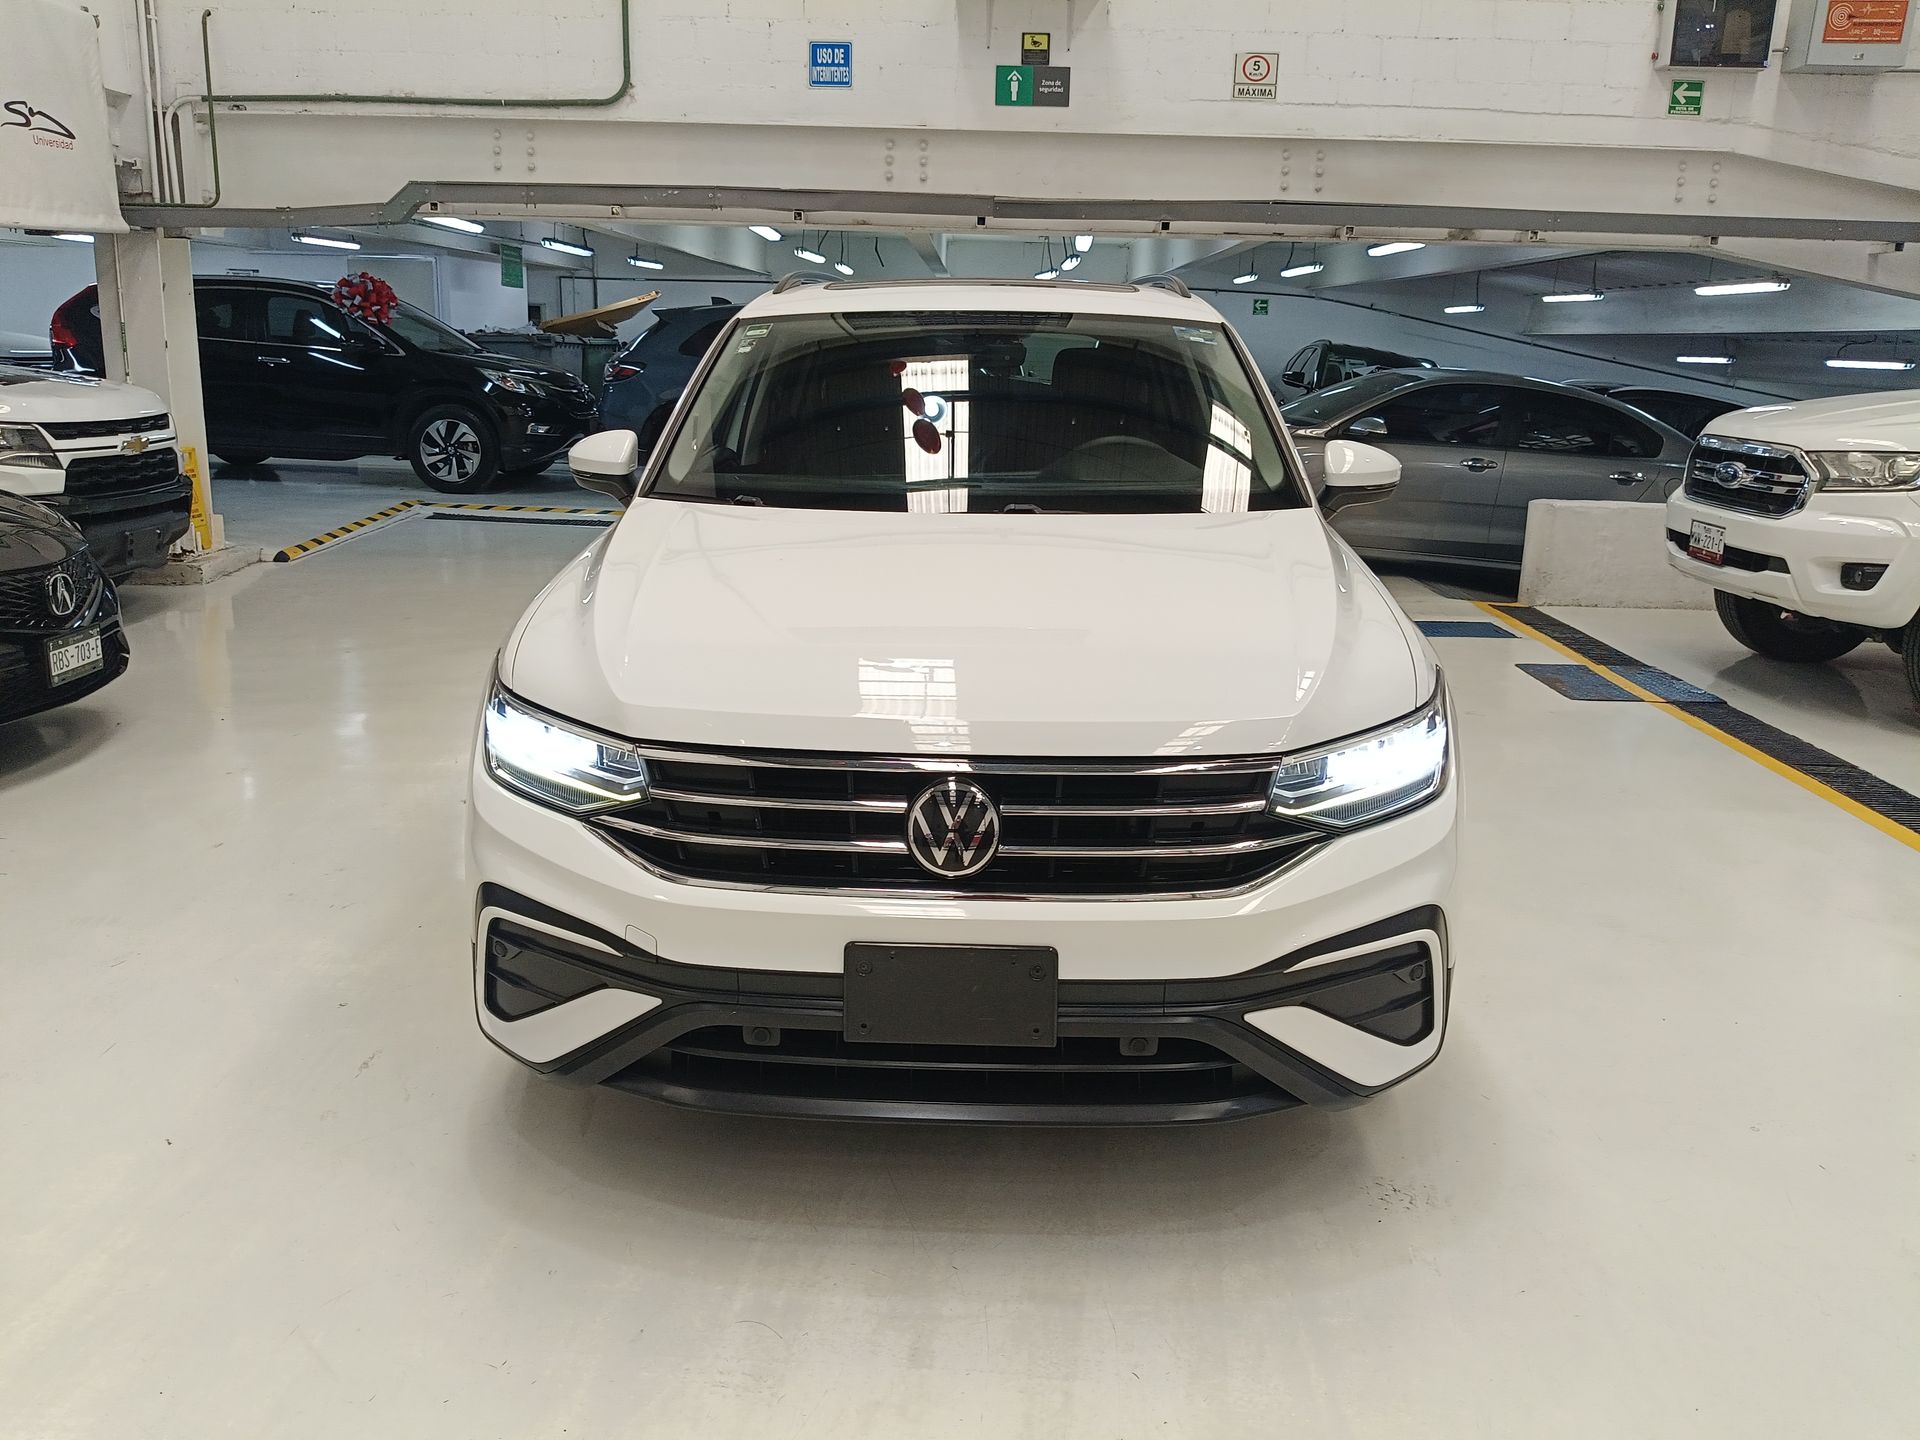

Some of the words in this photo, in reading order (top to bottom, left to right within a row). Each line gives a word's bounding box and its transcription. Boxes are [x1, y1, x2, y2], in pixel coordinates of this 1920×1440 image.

[816, 48, 833, 64] USO
[834, 48, 845, 64] DE
[1252, 60, 1261, 71] 5
[1237, 86, 1274, 98] MÁXIMA
[33, 134, 74, 151] Universidad
[51, 637, 101, 673] RBS-703-E
